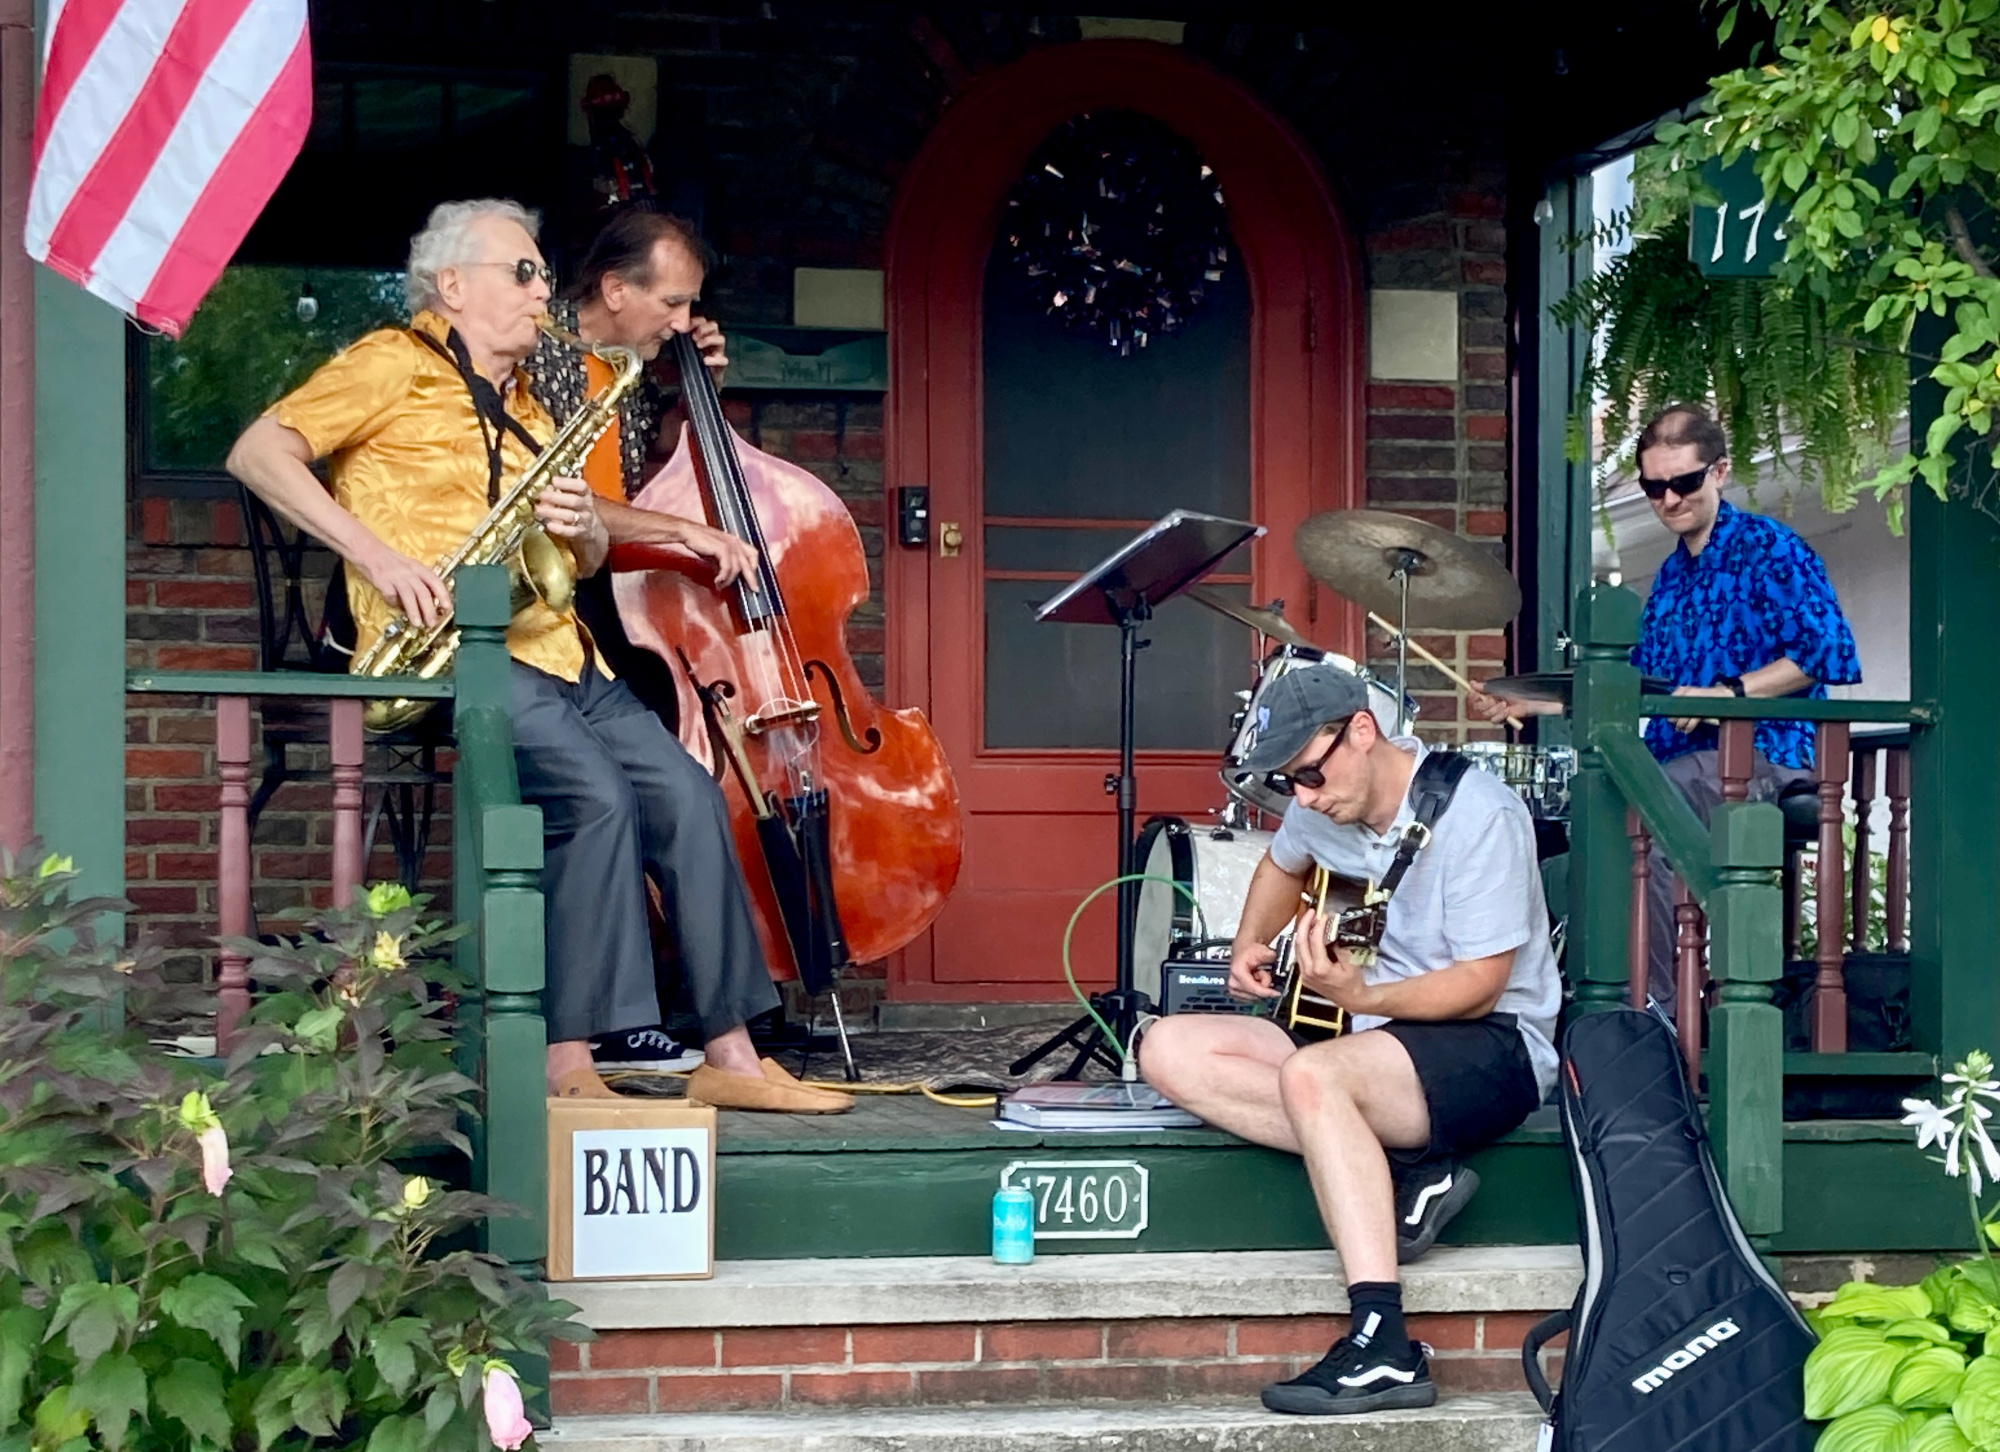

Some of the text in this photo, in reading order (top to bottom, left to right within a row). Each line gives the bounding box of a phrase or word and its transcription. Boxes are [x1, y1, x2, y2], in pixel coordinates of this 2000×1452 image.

[1711, 200, 1793, 263] 17
[583, 1147, 701, 1216] BAND
[1021, 1175, 1128, 1224] 7460
[1631, 1319, 1741, 1394] mono
